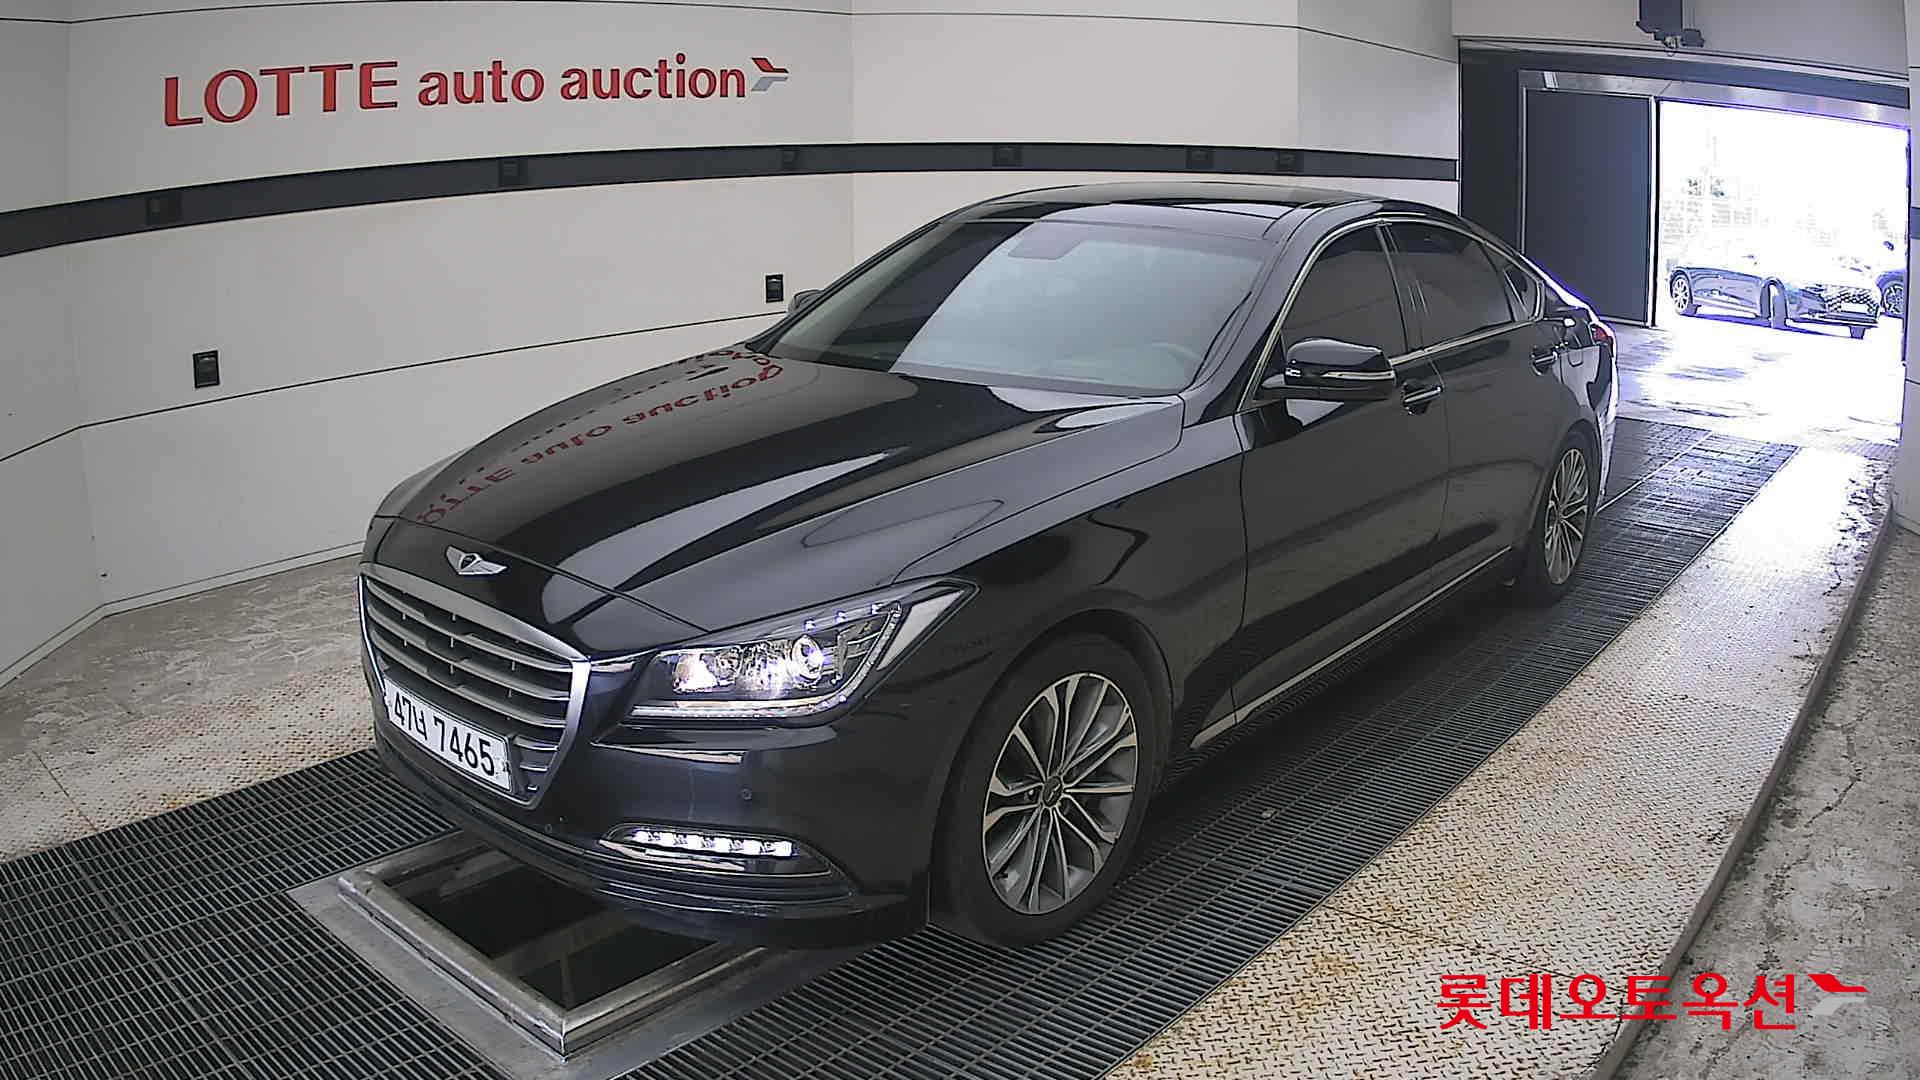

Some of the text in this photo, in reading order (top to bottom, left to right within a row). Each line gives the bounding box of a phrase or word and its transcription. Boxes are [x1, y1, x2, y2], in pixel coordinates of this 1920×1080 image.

[163, 53, 746, 127] LOTTE auto auction
[394, 691, 495, 777] 47너 7465
